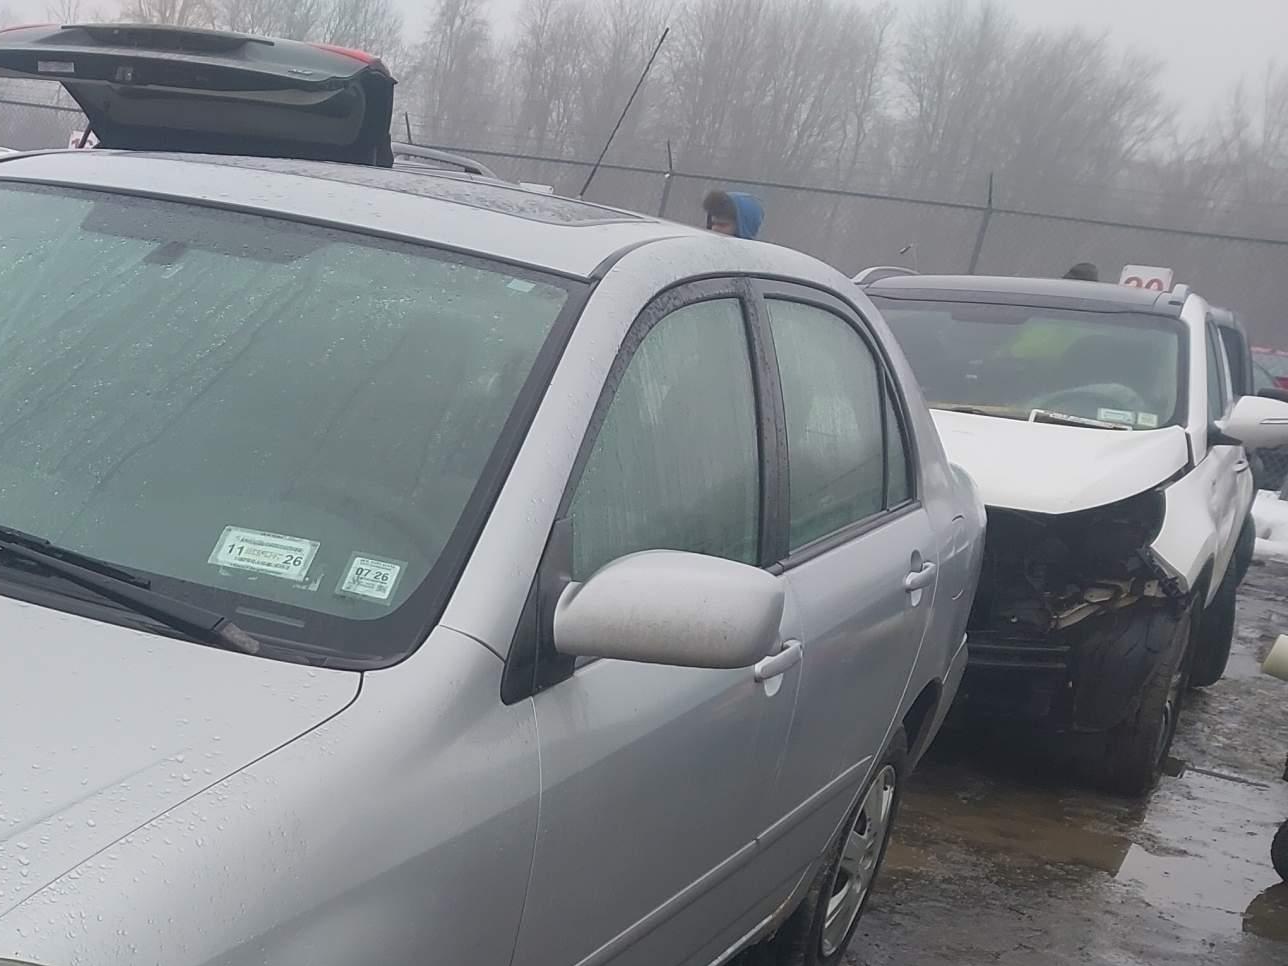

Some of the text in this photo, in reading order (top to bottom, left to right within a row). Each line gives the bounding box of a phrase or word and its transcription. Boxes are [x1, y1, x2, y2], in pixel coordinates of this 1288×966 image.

[227, 543, 245, 556] 11
[282, 554, 304, 567] 26
[355, 567, 390, 582] 07 26
